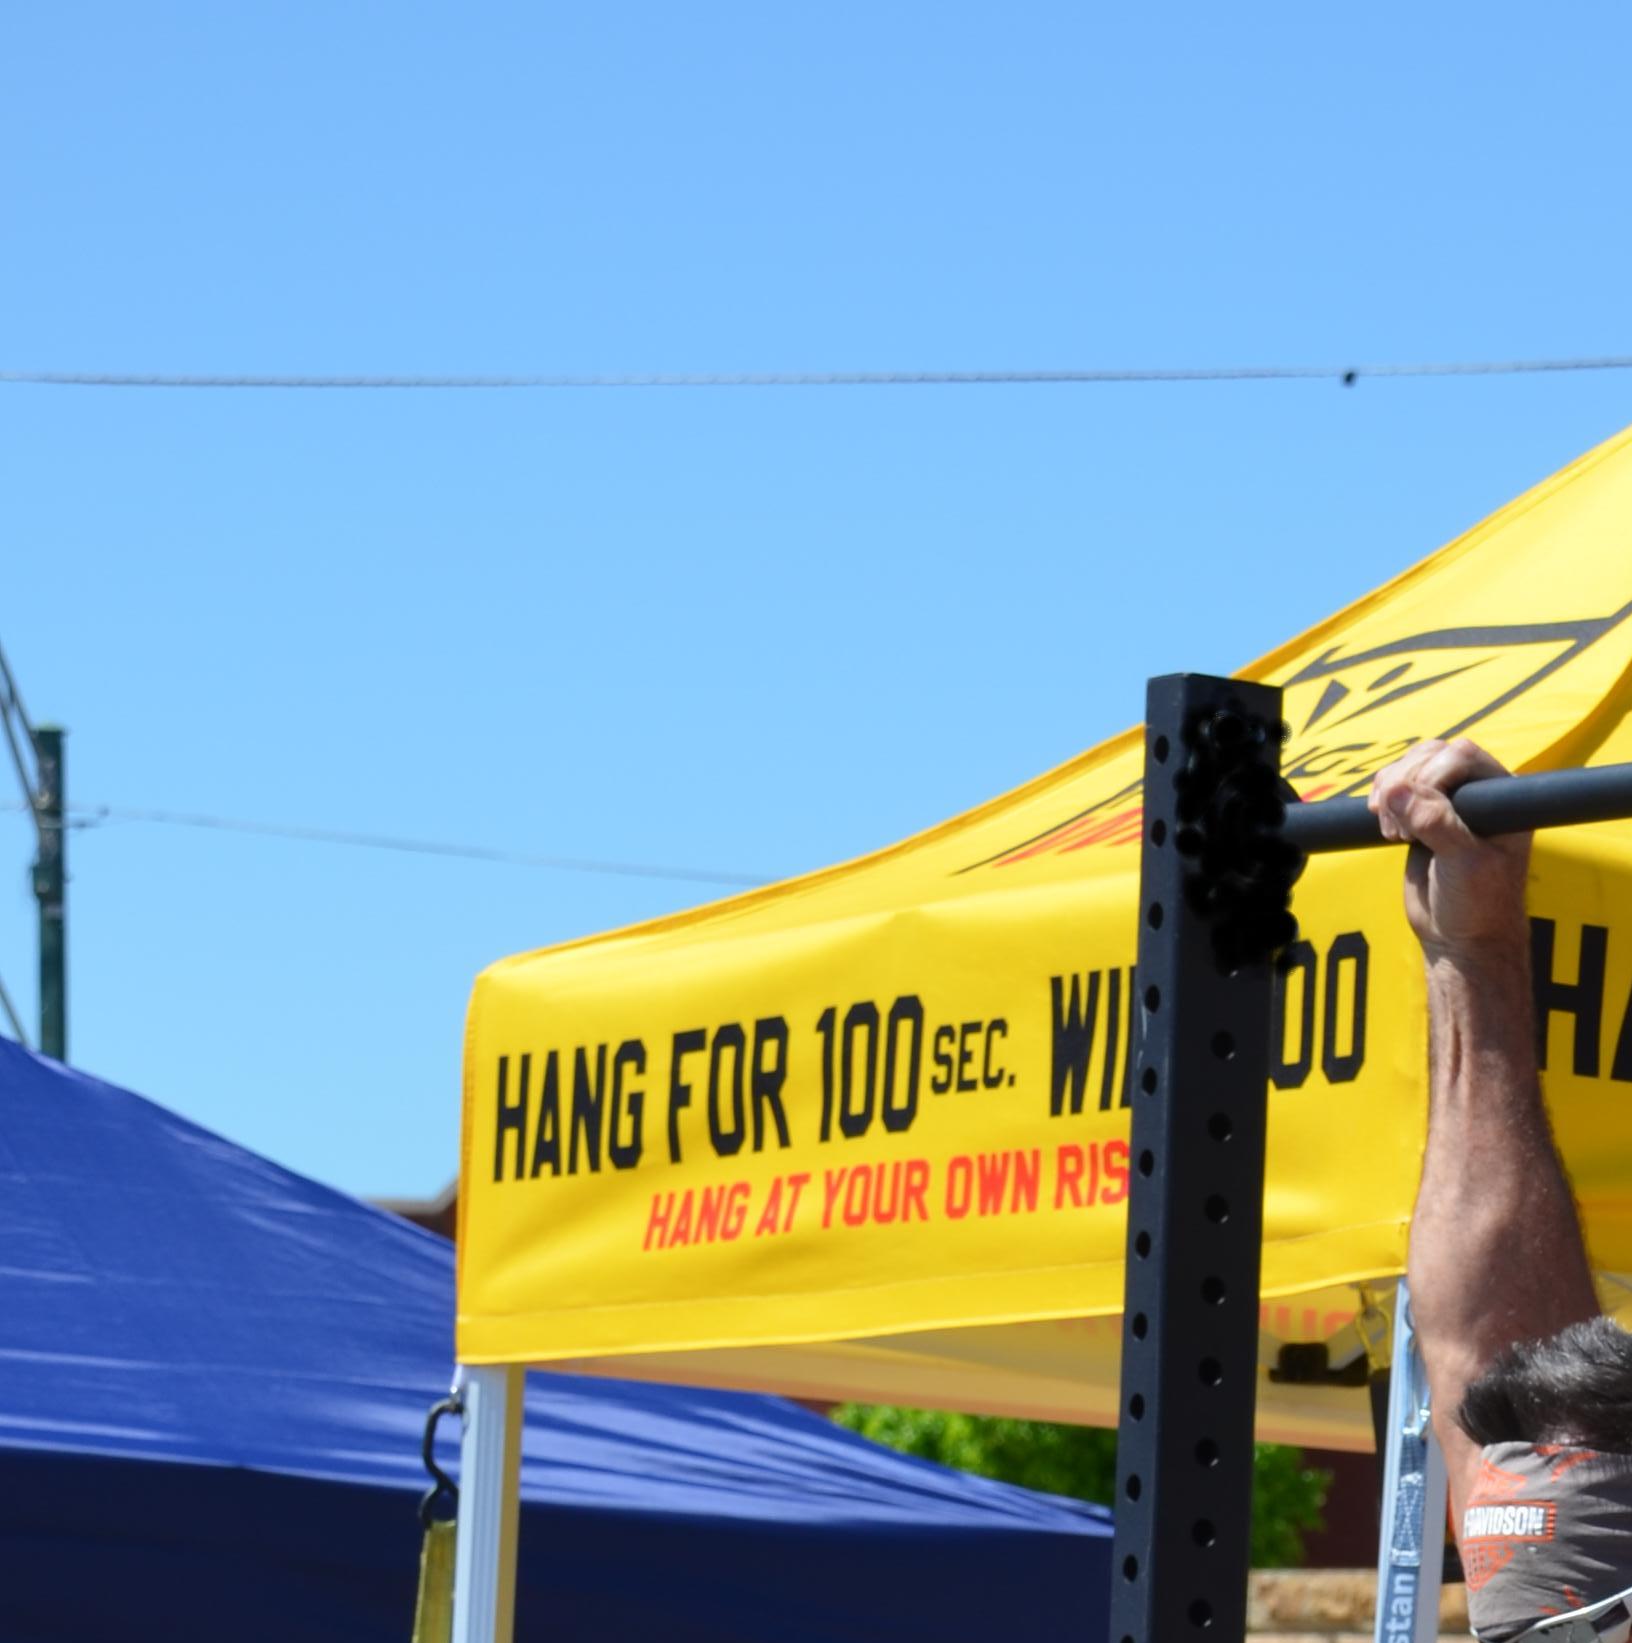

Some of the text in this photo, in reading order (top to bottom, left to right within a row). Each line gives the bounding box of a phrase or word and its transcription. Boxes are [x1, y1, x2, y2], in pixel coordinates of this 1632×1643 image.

[492, 1038, 647, 1184] HANG
[667, 1014, 791, 1164] FOR
[815, 994, 926, 1143] 100
[931, 1017, 1018, 1097] SEC.
[1267, 930, 1370, 1091] 00
[642, 1139, 1130, 1252] HANG AT YOUR OWN RIS
